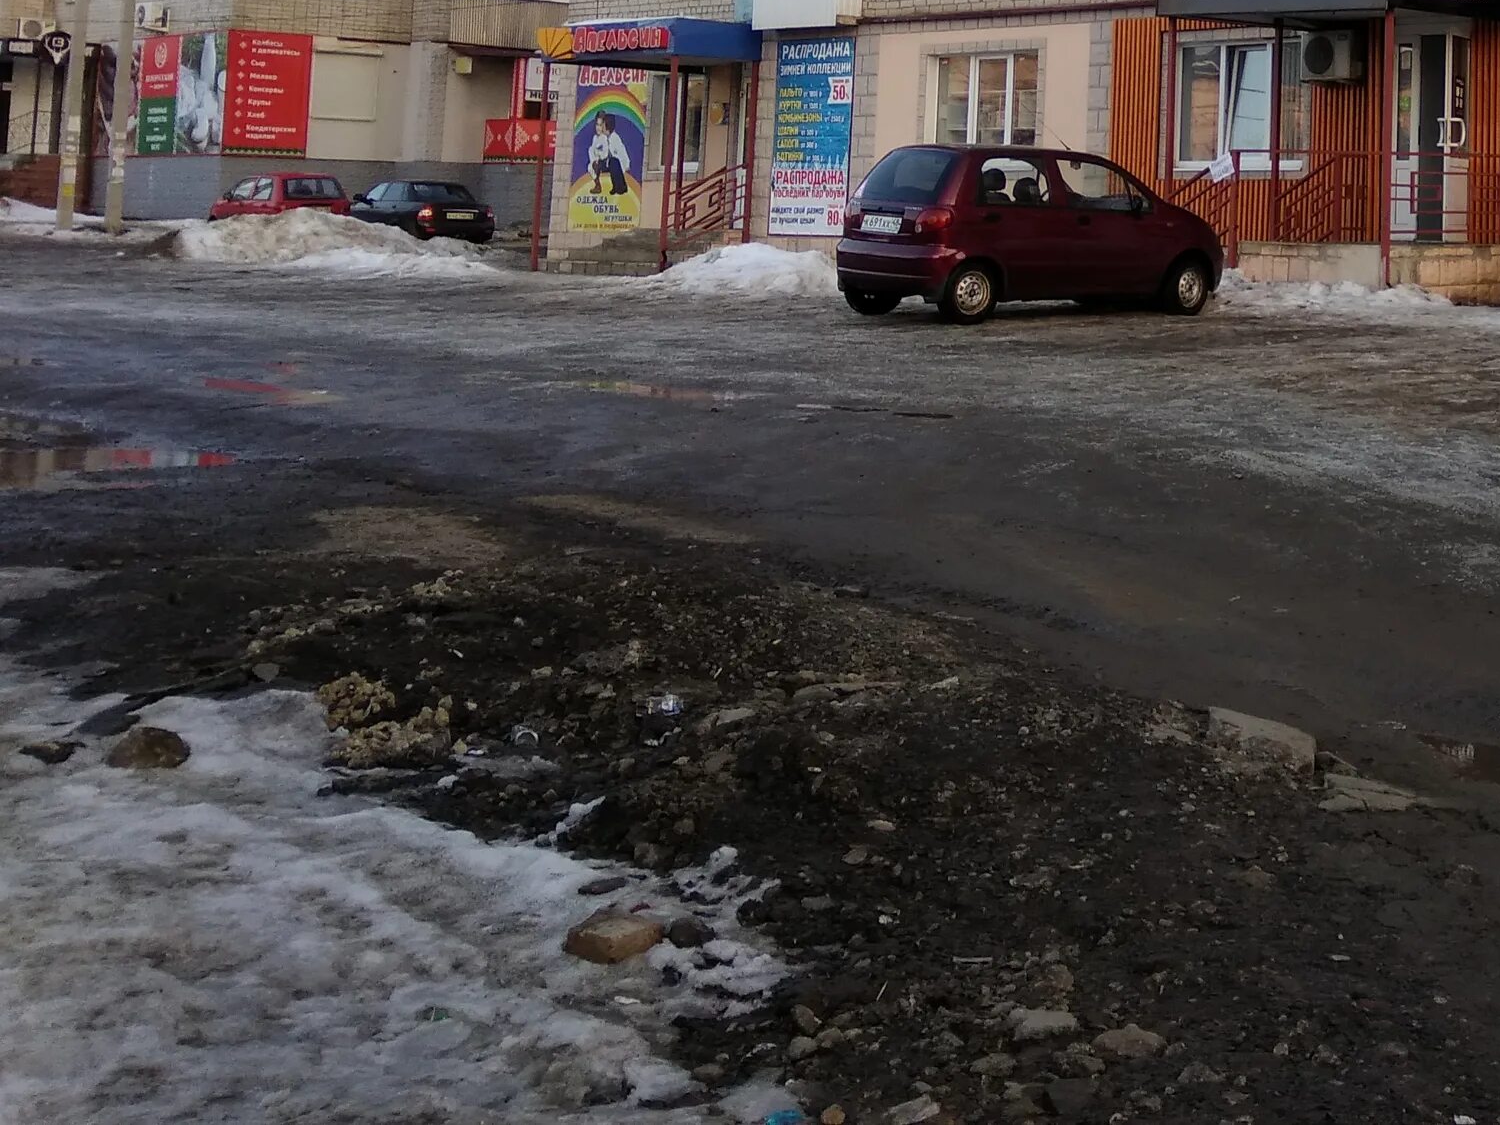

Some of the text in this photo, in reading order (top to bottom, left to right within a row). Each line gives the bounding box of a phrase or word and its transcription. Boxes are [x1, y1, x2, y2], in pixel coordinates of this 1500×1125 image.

[782, 41, 851, 61] РАСПРОДАЖА
[250, 59, 266, 67] Сыр
[780, 61, 851, 76] ЗИМНЕЙ КОЛЛЕКЦИИ
[248, 85, 284, 94] Консервы
[247, 98, 271, 107] Крупы
[779, 101, 802, 110] КУРТКИ
[246, 111, 265, 119] Хлеб
[776, 170, 845, 186] РАСПРОДАЖА
[811, 188, 823, 200] пар
[576, 195, 609, 204] ОДЕЖДА
[593, 204, 620, 213] ОБУВЬ
